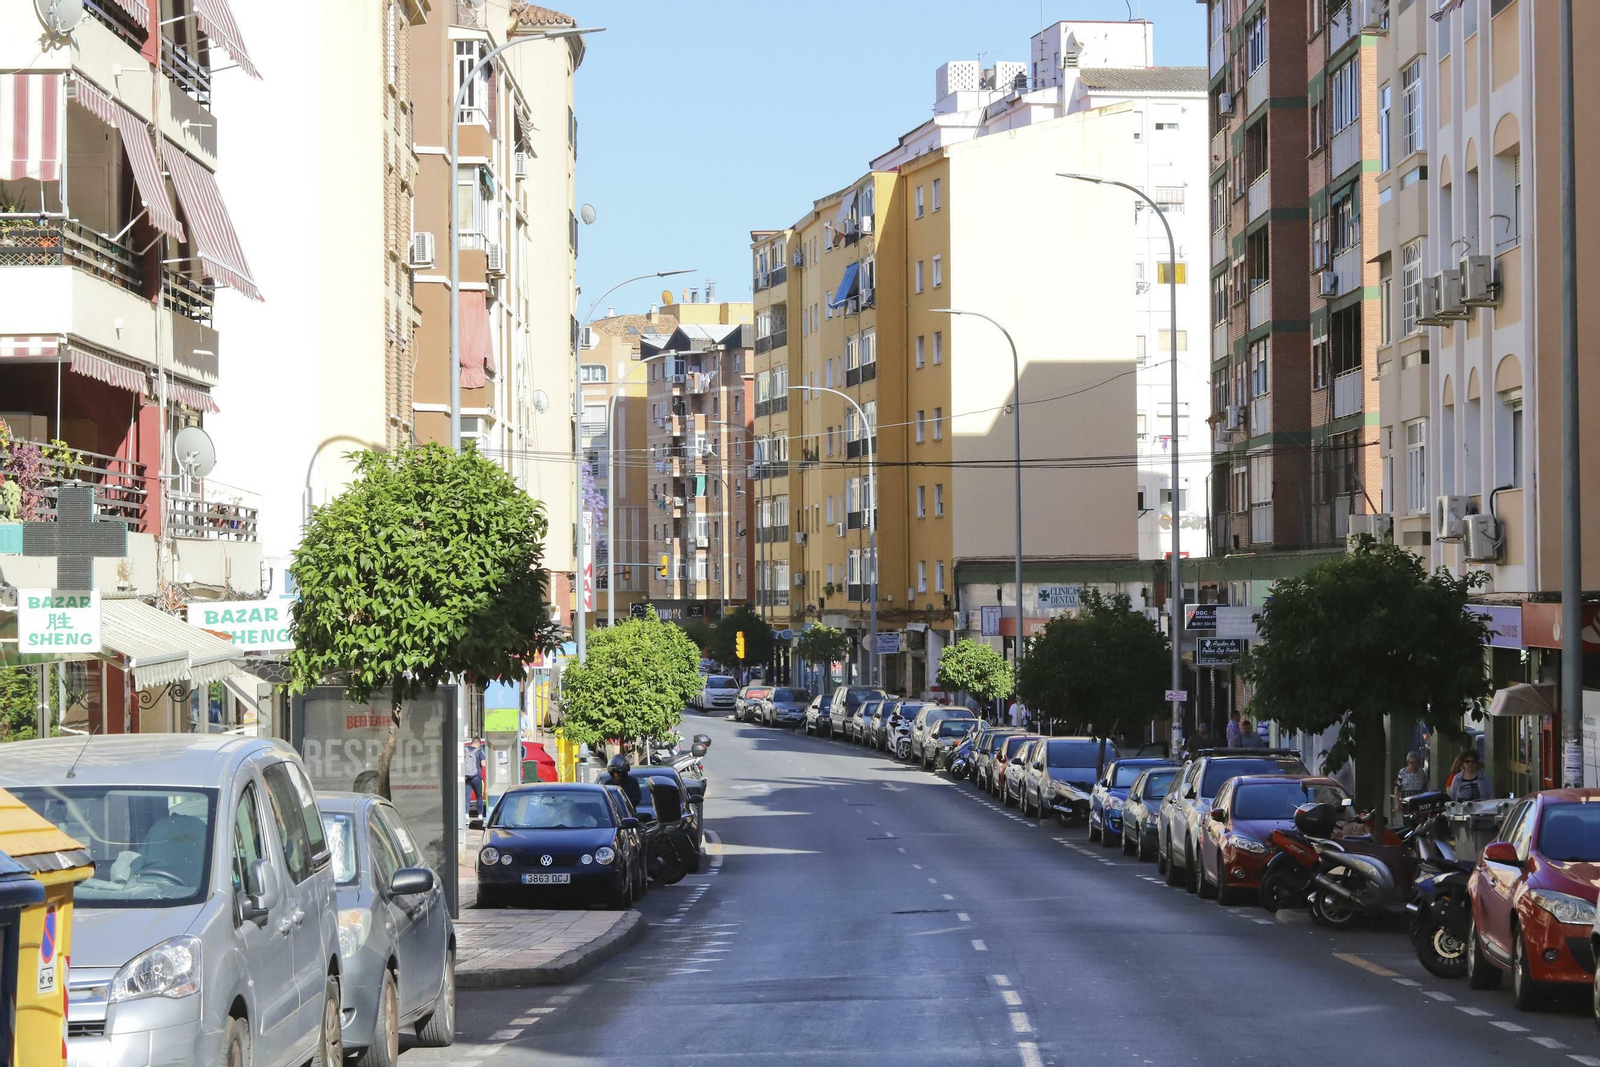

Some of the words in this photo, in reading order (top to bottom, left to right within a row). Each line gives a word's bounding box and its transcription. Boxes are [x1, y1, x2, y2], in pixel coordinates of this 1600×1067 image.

[28, 596, 92, 609] BAZAR
[1050, 595, 1077, 604] DENTAL
[46, 612, 74, 631] 胜
[204, 607, 279, 625] BAZAR
[28, 633, 93, 646] SHENG
[219, 628, 290, 645] HENG
[346, 715, 392, 730] BEEFEATE
[528, 874, 549, 883] 3863
[552, 874, 569, 883] DCJ
